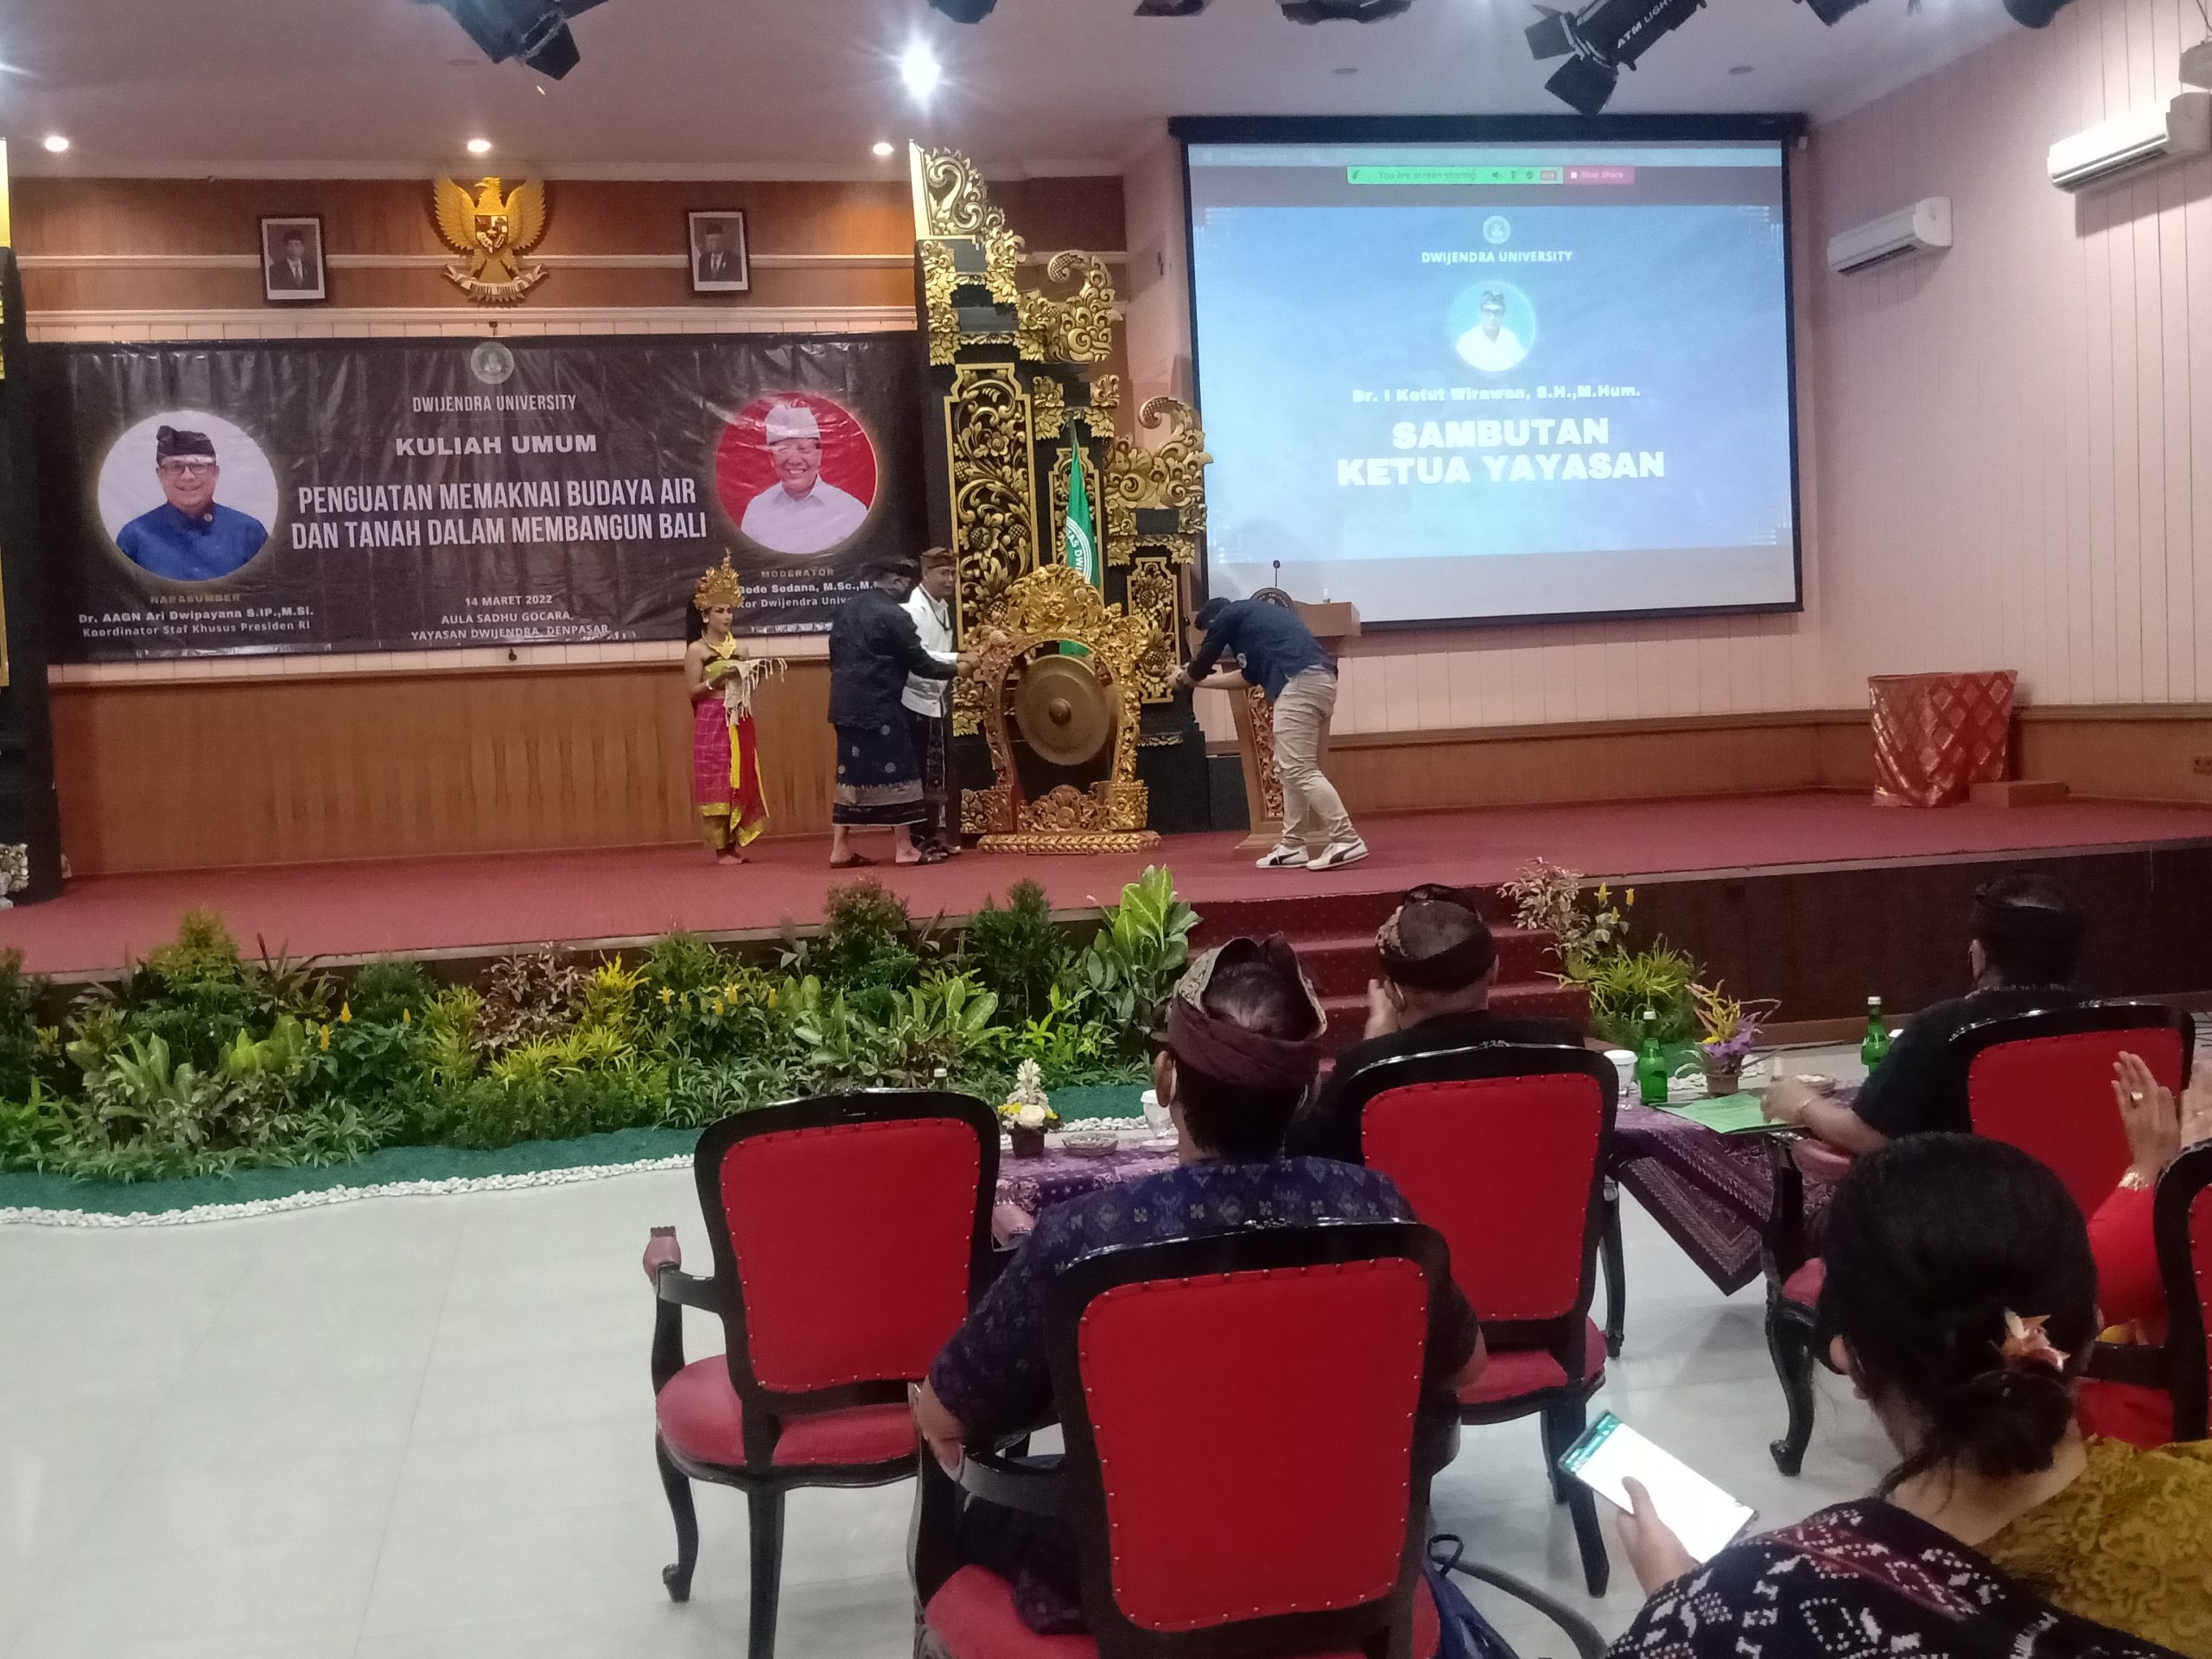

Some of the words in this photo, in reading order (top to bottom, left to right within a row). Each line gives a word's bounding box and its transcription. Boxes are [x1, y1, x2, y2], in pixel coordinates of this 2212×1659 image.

[1618, 21, 1642, 48] ATM
[1643, 0, 1673, 23] LIGH
[1421, 251, 1495, 265] DWIJENDRA
[1498, 251, 1573, 262] UNIVERSITY
[412, 396, 493, 412] DWIJENDRA
[496, 394, 576, 410] UNIVERSITY
[1352, 390, 1378, 403] Dr.
[1392, 417, 1609, 449] SAMBUTAN
[396, 436, 501, 455] KULIAH
[512, 435, 597, 454] UMUM
[1338, 455, 1471, 486] KETUA
[1482, 451, 1664, 483] YAYASAN
[299, 483, 433, 514] PENGUATAN
[440, 480, 561, 511] MEMAKNAI
[568, 479, 655, 507] BUDAYA
[660, 478, 696, 504] AIR
[292, 521, 339, 550] DAN
[345, 518, 422, 548] TANAH
[428, 516, 505, 546] DALAM
[512, 513, 653, 543] MEMBANGUN
[659, 512, 707, 538] BALI
[1074, 549, 1084, 570] DWI
[761, 568, 834, 578] MODERATOR
[465, 597, 478, 607] 14
[482, 596, 522, 606] MARET
[525, 594, 553, 605] 2022
[760, 597, 817, 609] Dwijendra
[822, 596, 851, 605] Univ
[79, 613, 98, 623] Dr.
[103, 612, 141, 623] AAGN
[146, 611, 165, 620] Ari
[169, 610, 242, 621] Dwipayana
[442, 614, 474, 625] AULA
[477, 613, 518, 623] SADHU
[83, 626, 159, 637] Koordinator
[163, 624, 188, 634] Staf
[193, 623, 237, 633] Khusus
[241, 621, 294, 632] Presiden
[299, 620, 311, 629] RI
[411, 629, 467, 640] YAYASAN
[546, 624, 609, 635] DENPASAR
